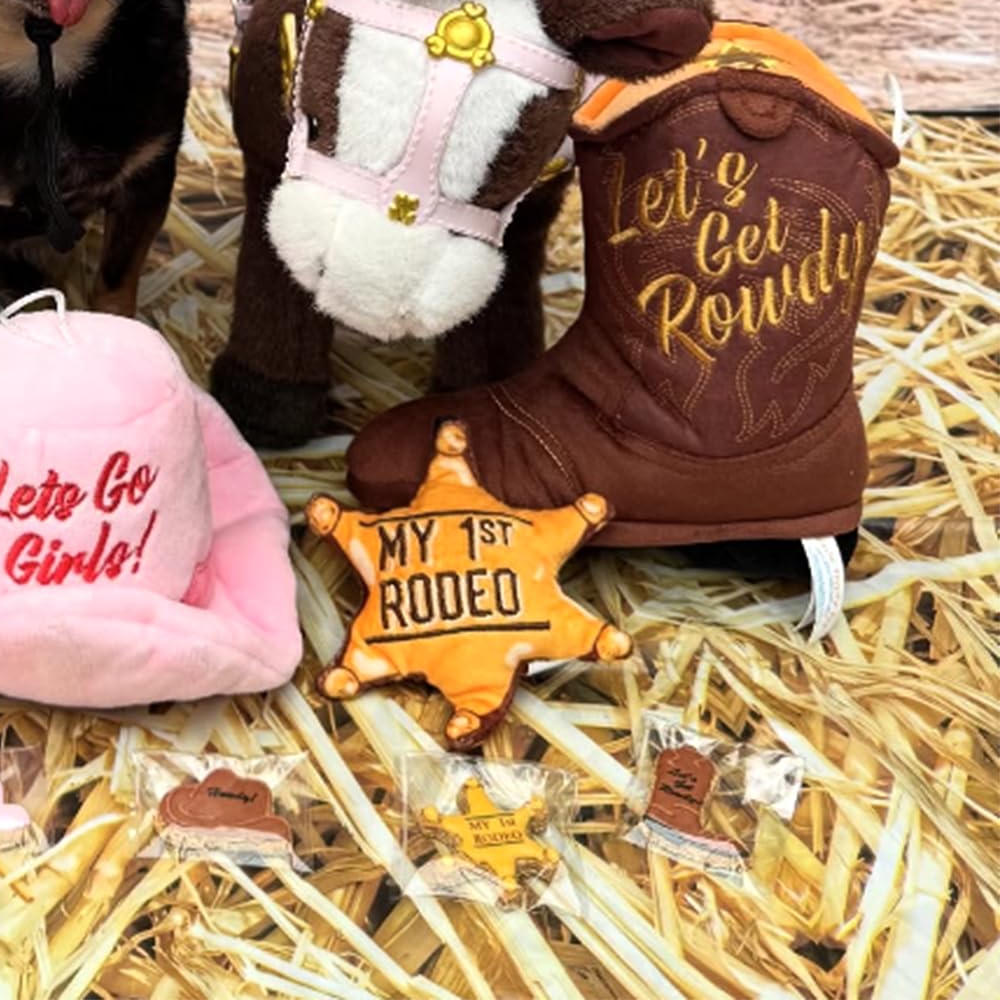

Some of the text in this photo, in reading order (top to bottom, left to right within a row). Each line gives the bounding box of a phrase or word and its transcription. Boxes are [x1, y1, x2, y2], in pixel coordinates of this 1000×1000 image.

[602, 138, 758, 245] Let's
[696, 197, 790, 276] Get
[637, 207, 865, 366] Rowdy
[93, 451, 160, 513] Go
[4, 509, 157, 585] Girls!
[378, 516, 512, 571] MY 1ST
[379, 567, 520, 630] RODEO
